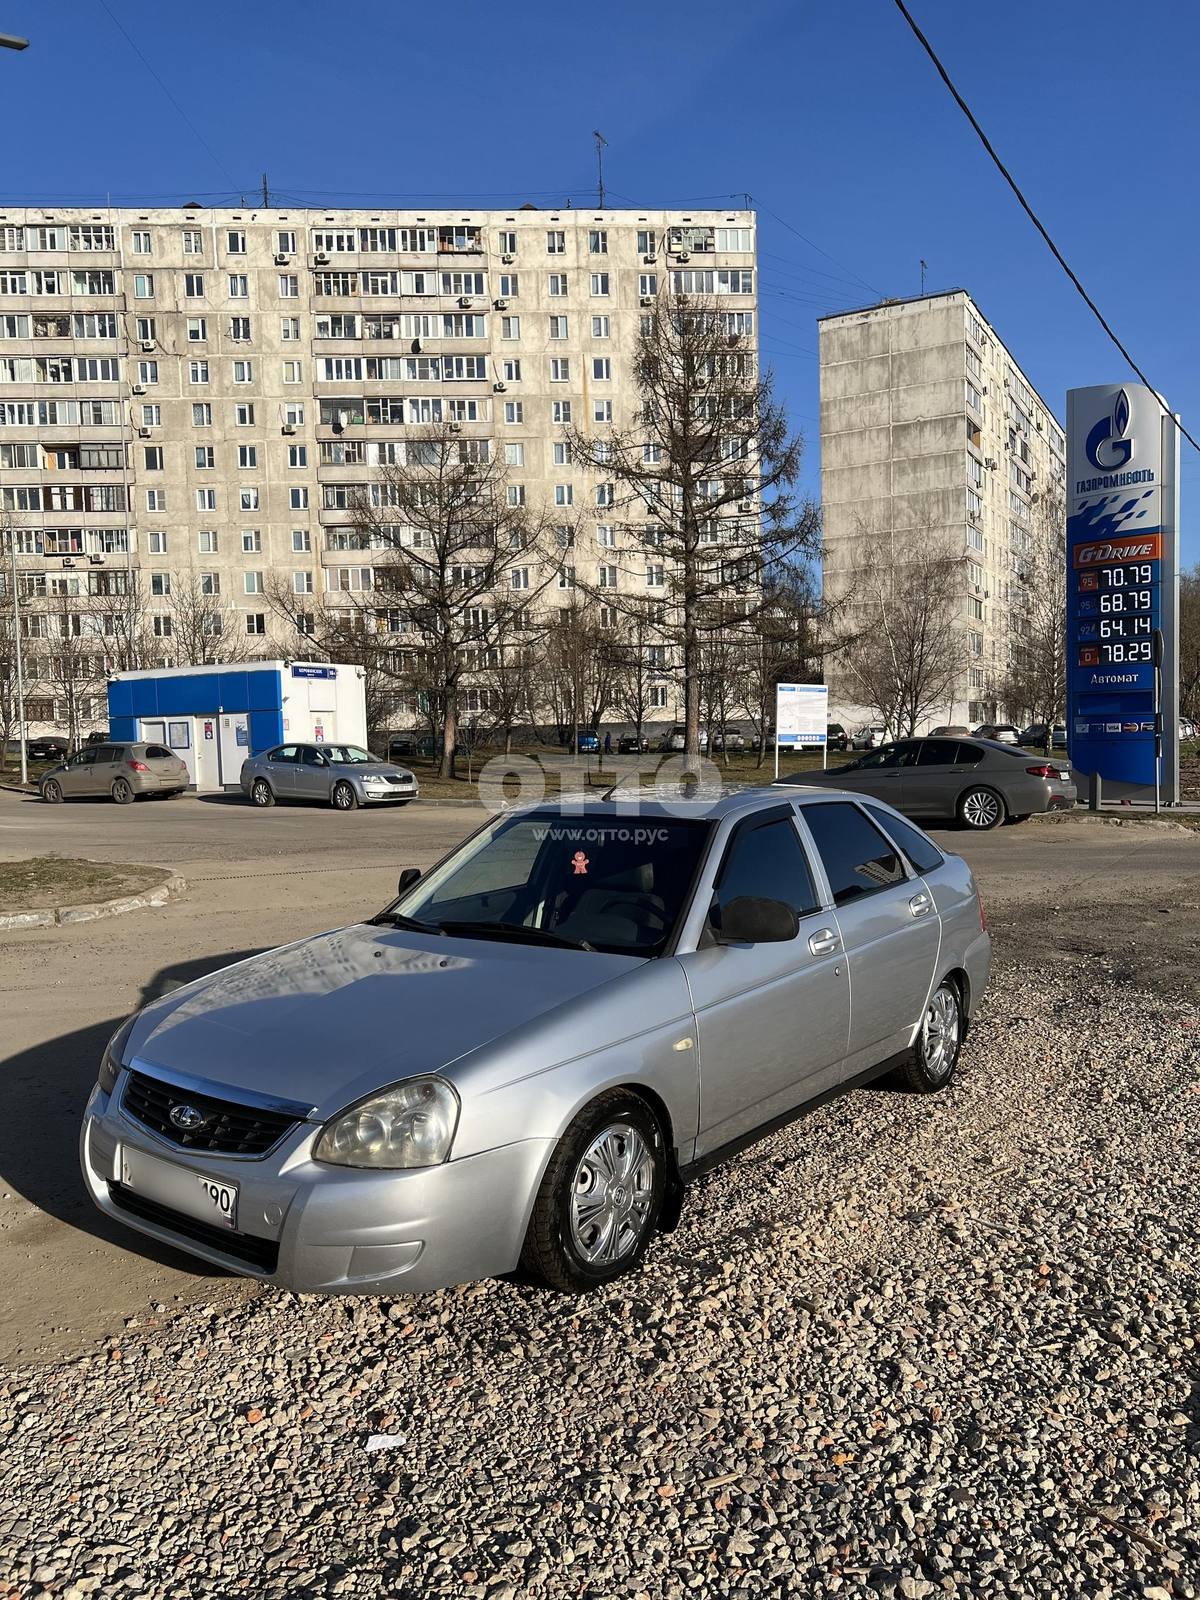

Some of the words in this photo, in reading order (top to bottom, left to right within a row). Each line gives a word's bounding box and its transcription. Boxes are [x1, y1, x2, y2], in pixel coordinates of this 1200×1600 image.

[1076, 468, 1155, 494] ГАЗПРОМНЕФТЬ
[1082, 577, 1093, 587] 95
[1102, 564, 1152, 587] 70.79
[1100, 590, 1151, 613] 68.79
[1100, 617, 1151, 638] 64.14
[1102, 642, 1152, 662] 78.29
[1090, 673, 1139, 685] Автомат
